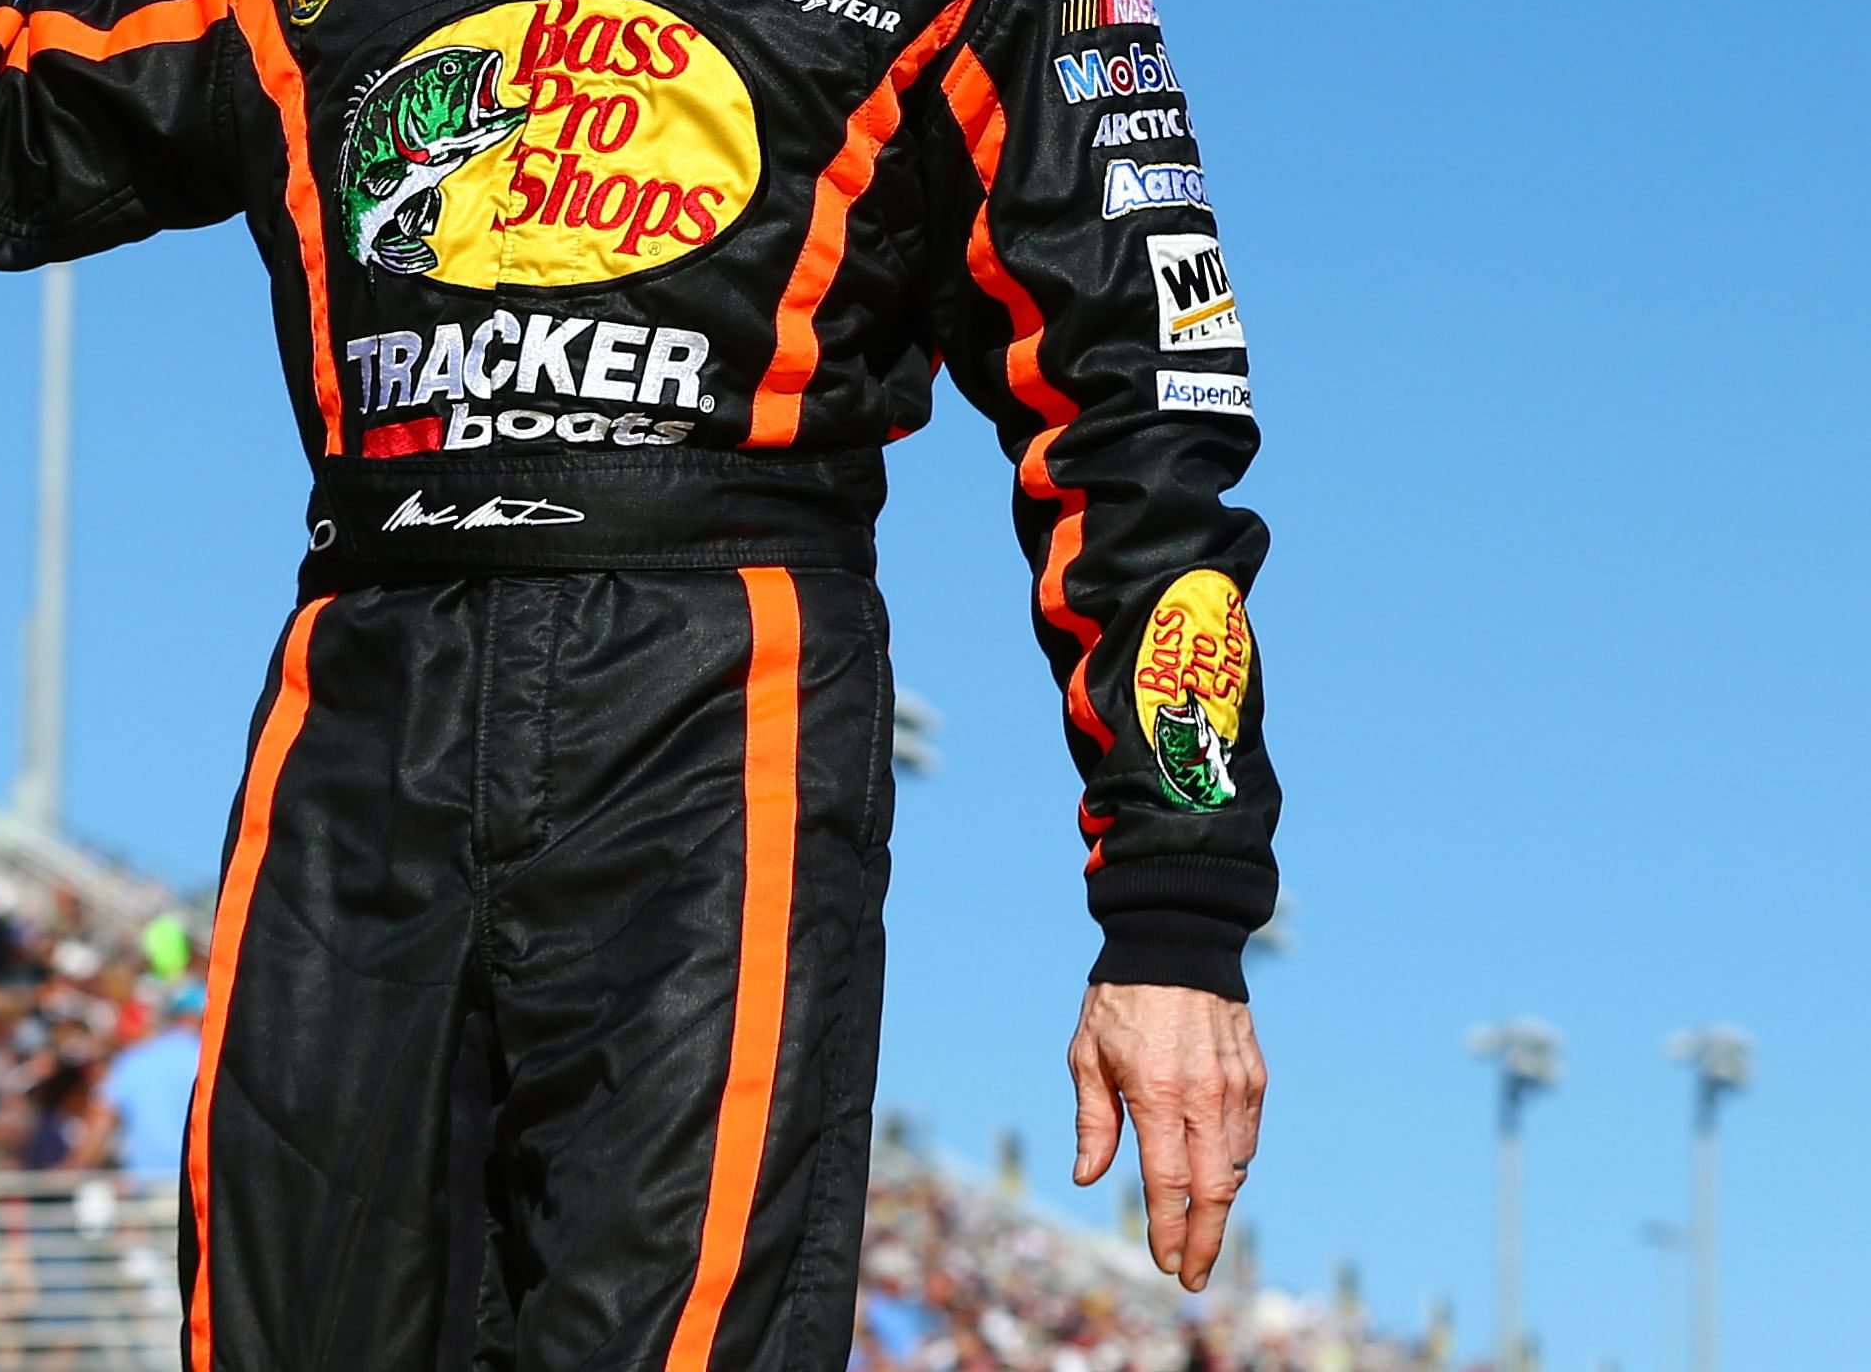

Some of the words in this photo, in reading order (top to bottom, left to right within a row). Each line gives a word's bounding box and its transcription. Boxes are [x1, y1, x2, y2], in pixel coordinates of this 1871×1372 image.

[1054, 42, 1183, 104] Mobi
[528, 71, 638, 154] Pro
[1091, 108, 1184, 147] ARCTIC
[492, 140, 725, 257] Shops
[1104, 161, 1212, 217] Aaro
[1170, 308, 1239, 345] FILTE
[346, 309, 711, 415] TRACKER
[1162, 375, 1251, 409] AspenDe
[443, 402, 697, 452] boats
[1137, 609, 1185, 700] Bass
[1180, 633, 1218, 700] Pro
[1213, 591, 1246, 707] Shops
